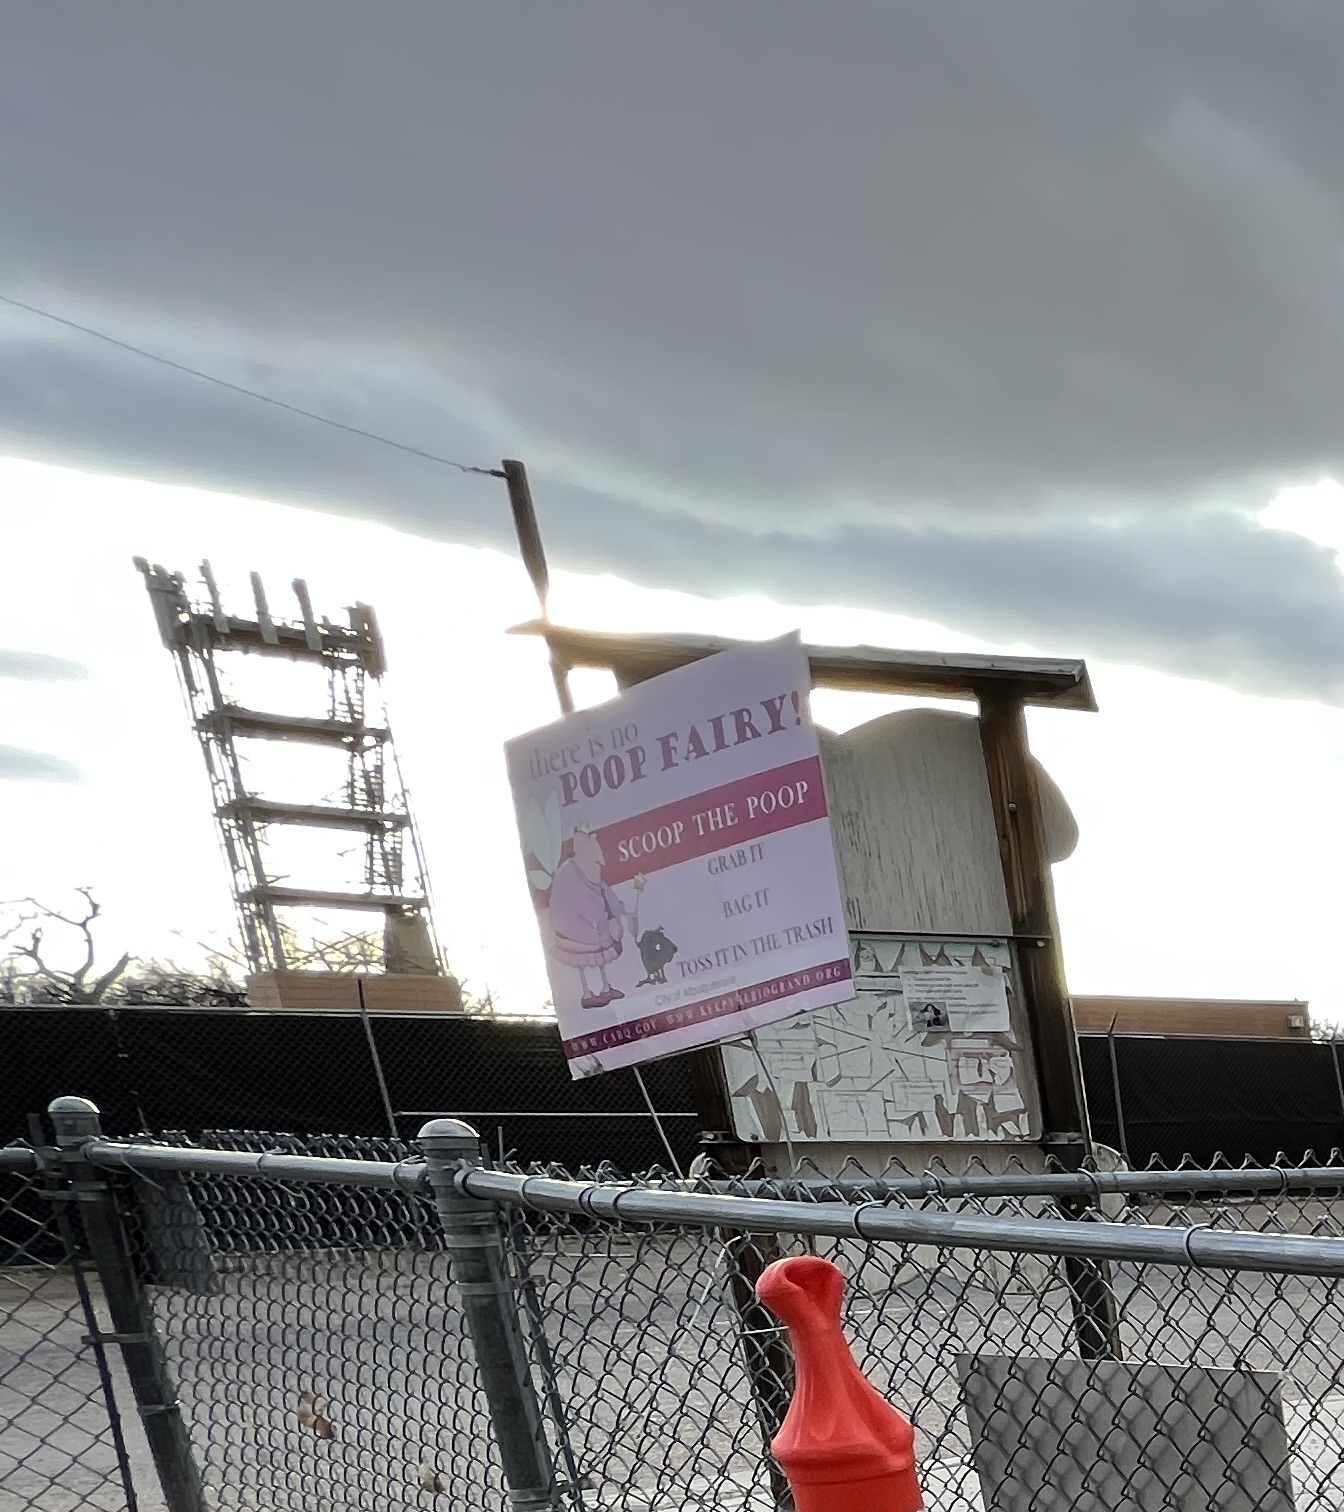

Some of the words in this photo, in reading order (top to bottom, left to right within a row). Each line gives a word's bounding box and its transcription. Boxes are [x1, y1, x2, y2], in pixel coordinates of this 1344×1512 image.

[529, 742, 580, 780] there
[586, 727, 604, 757] is
[610, 722, 638, 750] no
[558, 745, 647, 808] POOP
[656, 690, 801, 772] FAIRY!
[618, 821, 685, 862] SCOOP
[692, 803, 739, 836] THE
[746, 780, 808, 819] POOP
[707, 847, 747, 876] GRAB
[750, 842, 765, 864] IT
[722, 893, 753, 919] BAG
[755, 888, 770, 908] IT
[677, 952, 713, 978] TOSS
[714, 947, 729, 967] IT
[732, 943, 748, 961] IN
[749, 933, 782, 956] THE
[782, 916, 834, 945] TRASH
